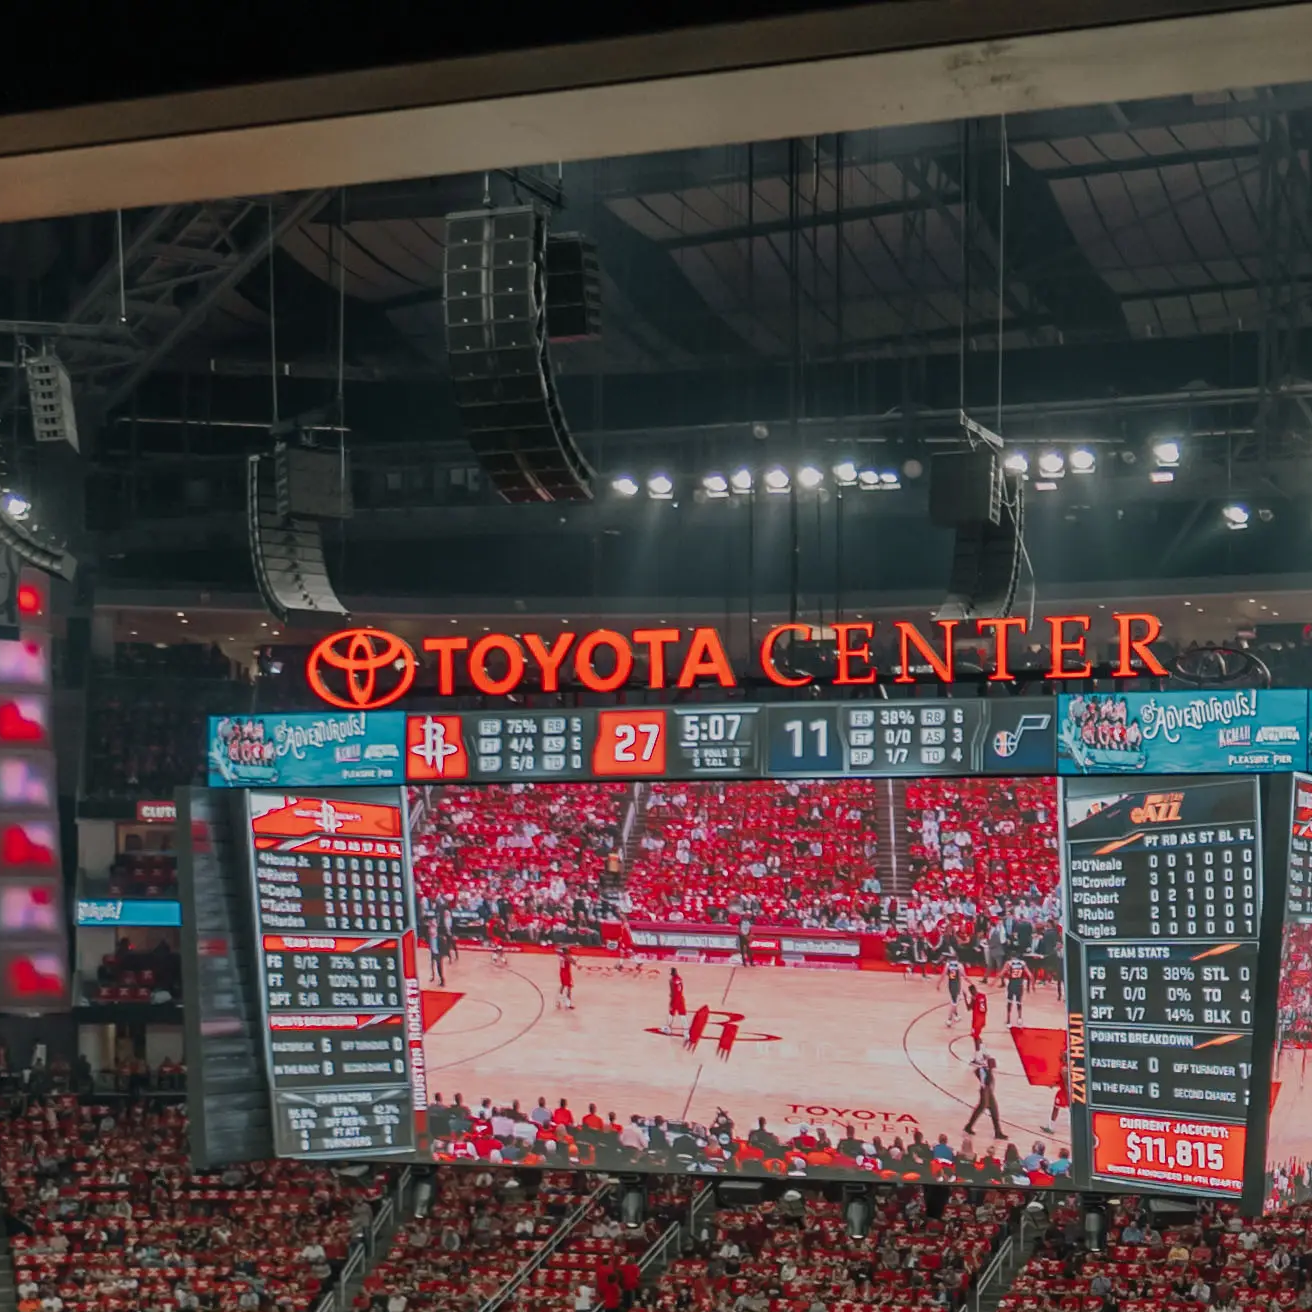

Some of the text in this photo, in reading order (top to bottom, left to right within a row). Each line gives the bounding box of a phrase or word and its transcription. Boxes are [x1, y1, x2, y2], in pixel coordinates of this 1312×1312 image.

[423, 613, 1169, 695] TOYOTA CENTER
[880, 710, 914, 725] 38%
[953, 709, 964, 723] 6
[507, 718, 582, 734] 75% 5
[682, 715, 741, 741] 5:07
[614, 724, 660, 762] 27
[784, 720, 828, 757] 11
[854, 728, 963, 744] FT 0/0 AS 3
[510, 737, 582, 752] 4/4 AS 5
[510, 755, 582, 771] 5/8 0
[888, 749, 908, 764] 1/7
[951, 748, 962, 762] 4
[1229, 753, 1292, 765] PLEASURE PIER
[1130, 800, 1183, 824] JAZZ
[1144, 829, 1254, 847] PT RB AS ST BL FL
[1082, 852, 1193, 871] O'Neale 0 0 1
[1082, 876, 1126, 888] Crowder
[1083, 893, 1119, 904] Gobert
[1084, 908, 1114, 921] Rubio
[1085, 925, 1116, 938] Ingles
[1107, 947, 1170, 959] TEAM STATS
[267, 955, 283, 968] FG
[360, 957, 380, 970] STL
[386, 958, 395, 970] 3
[268, 974, 283, 986] FT
[297, 975, 318, 988] 4/4
[1090, 966, 1249, 982] FG 5/13 38% STL 0
[1091, 986, 1251, 1002] FT 0/0 0% TO 4
[1091, 1007, 1250, 1024] 3PT 1/7 14% BLK 0
[1069, 1013, 1085, 1058] UTAH
[1091, 1032, 1193, 1046] POINTS BREAKDOWN
[1091, 1058, 1138, 1070] FASTBREAK
[1148, 1057, 1159, 1073] 0
[1190, 1064, 1236, 1076] TURNOVER
[1070, 1060, 1086, 1104] JAZZ
[1103, 1083, 1118, 1093] THE
[1149, 1082, 1159, 1098] 6
[787, 1102, 920, 1125] TOYOTA
[1120, 1117, 1229, 1139] CURRENT JACKPOT:
[1127, 1132, 1224, 1170] $11,815
